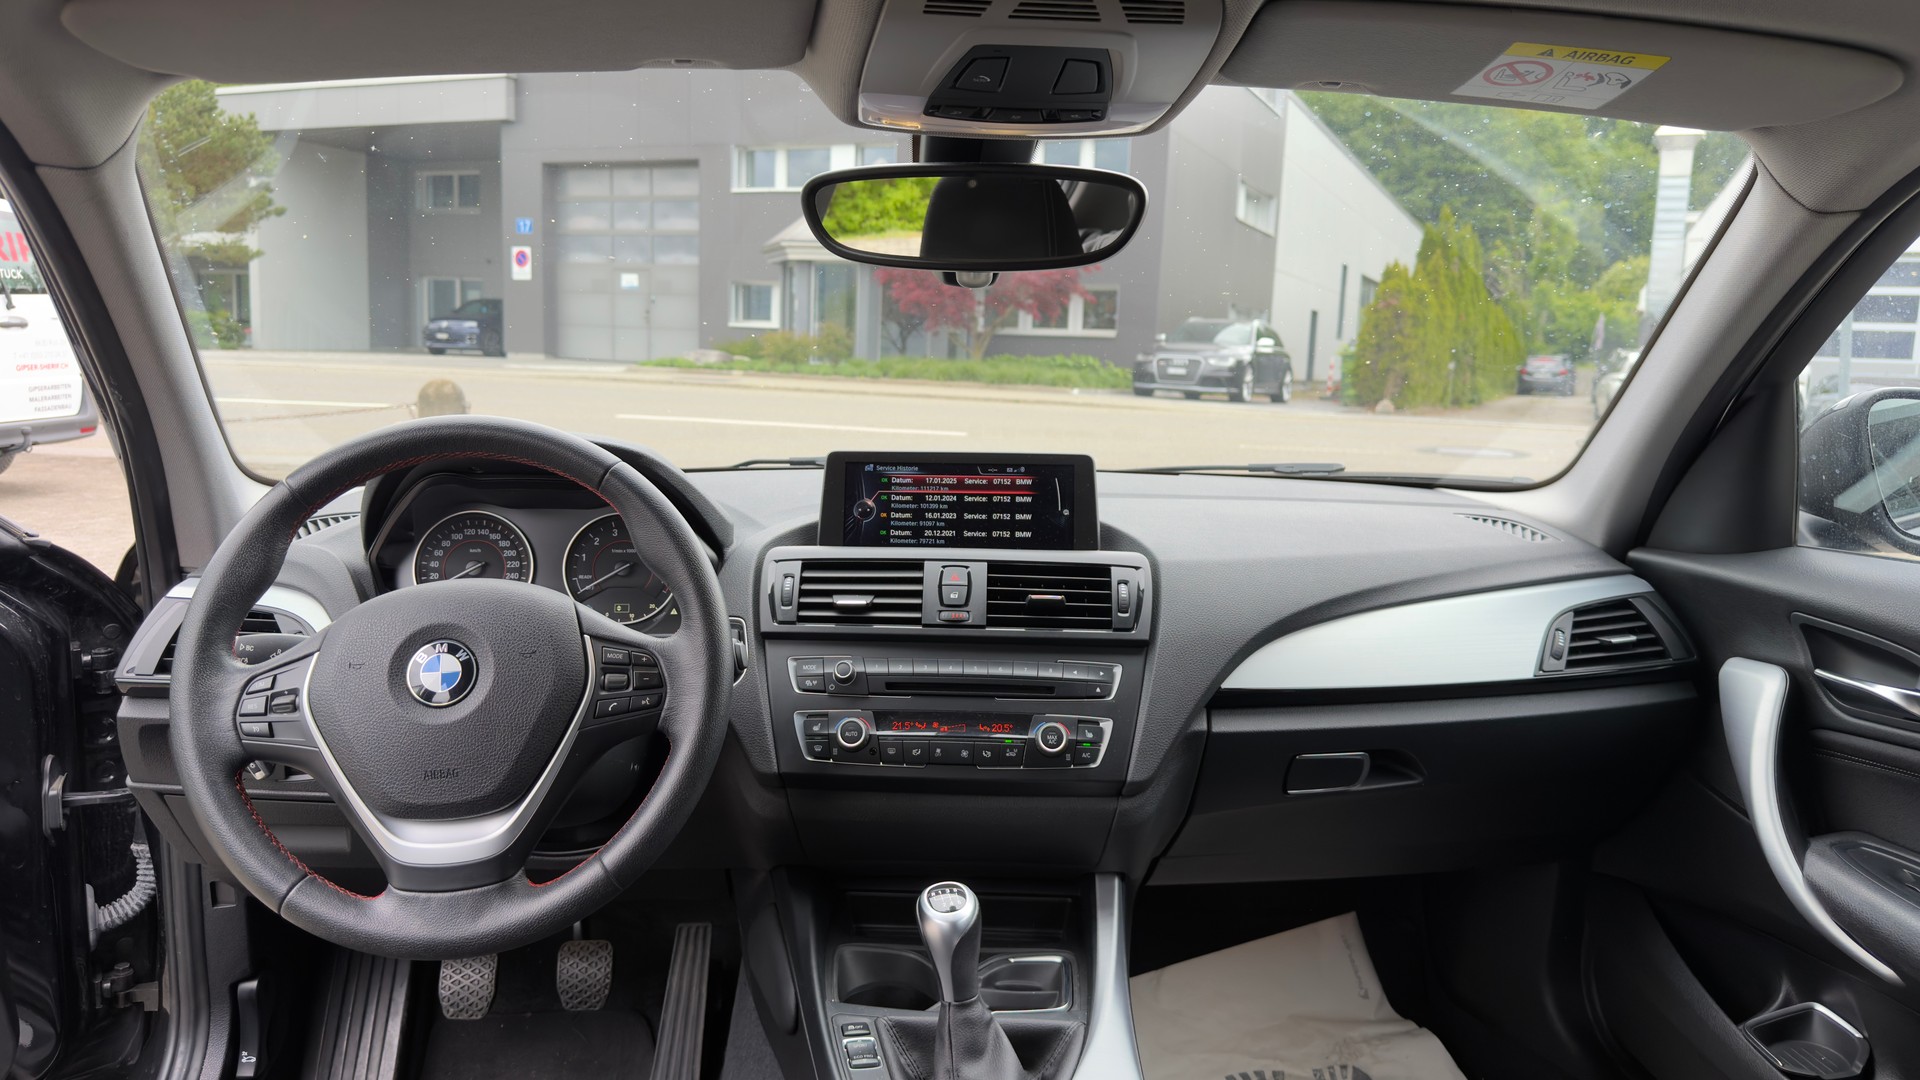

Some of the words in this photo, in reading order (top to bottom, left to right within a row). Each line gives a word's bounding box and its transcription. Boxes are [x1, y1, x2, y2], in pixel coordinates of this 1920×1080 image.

[1562, 50, 1636, 65] AIRBAG
[519, 220, 531, 232] 17
[28, 394, 72, 402] MALERARBEITEN
[464, 528, 476, 536] 120
[477, 528, 490, 536] 140
[489, 532, 501, 540] 160
[593, 537, 600, 545] 2
[582, 553, 586, 561] 1
[505, 572, 519, 580] 240
[414, 642, 470, 664] BMW
[607, 652, 624, 660] MODE
[892, 721, 914, 730] 21.5°
[991, 724, 1013, 733] 20.5°
[423, 769, 459, 780] AIRBAG
